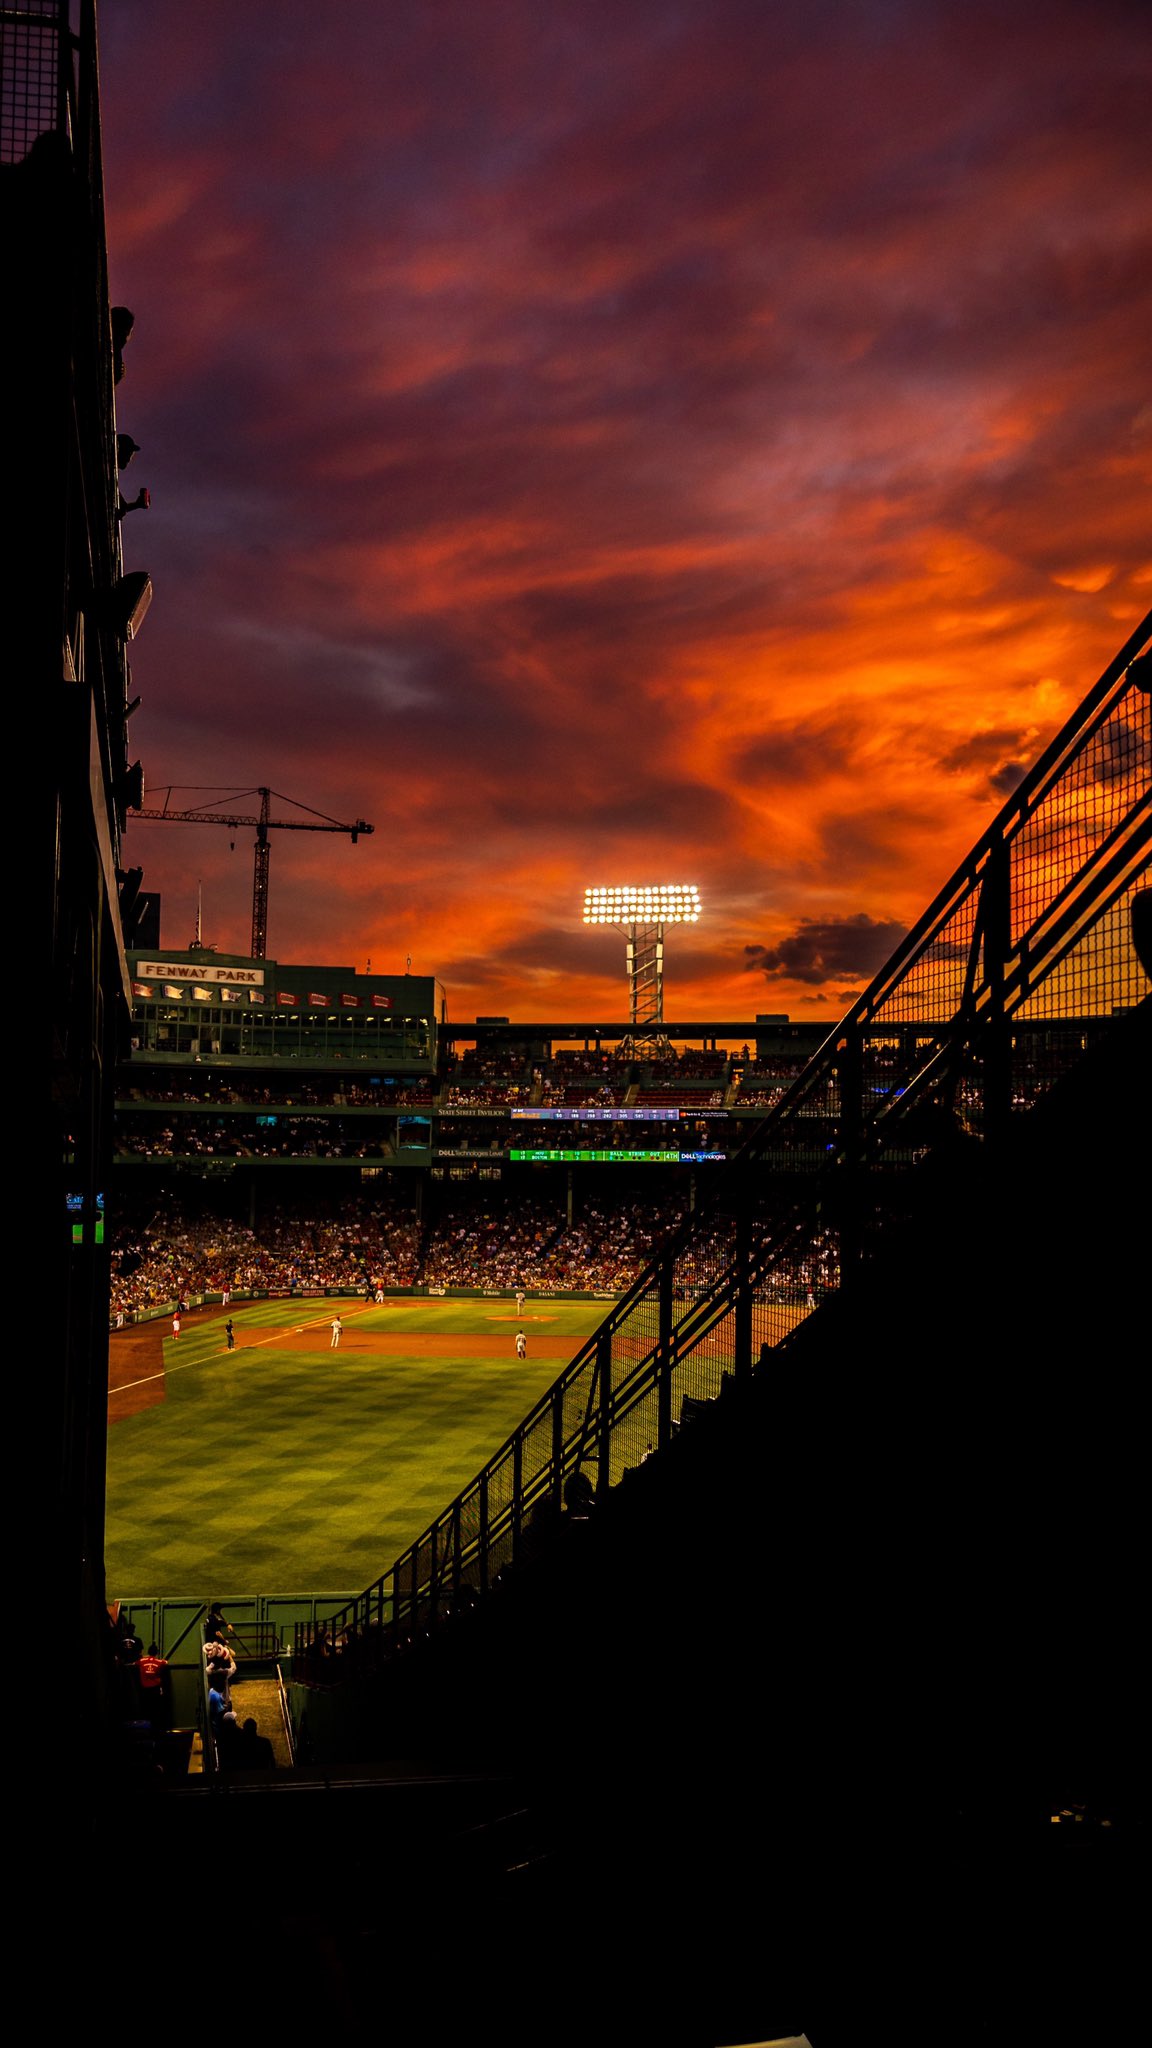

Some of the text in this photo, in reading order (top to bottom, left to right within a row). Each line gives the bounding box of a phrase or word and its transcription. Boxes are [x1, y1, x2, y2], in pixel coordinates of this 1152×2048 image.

[146, 965, 256, 981] FENWAY PARK
[438, 1108, 455, 1116] STATE
[456, 1108, 476, 1116] STREET
[477, 1108, 505, 1116] PAVILION
